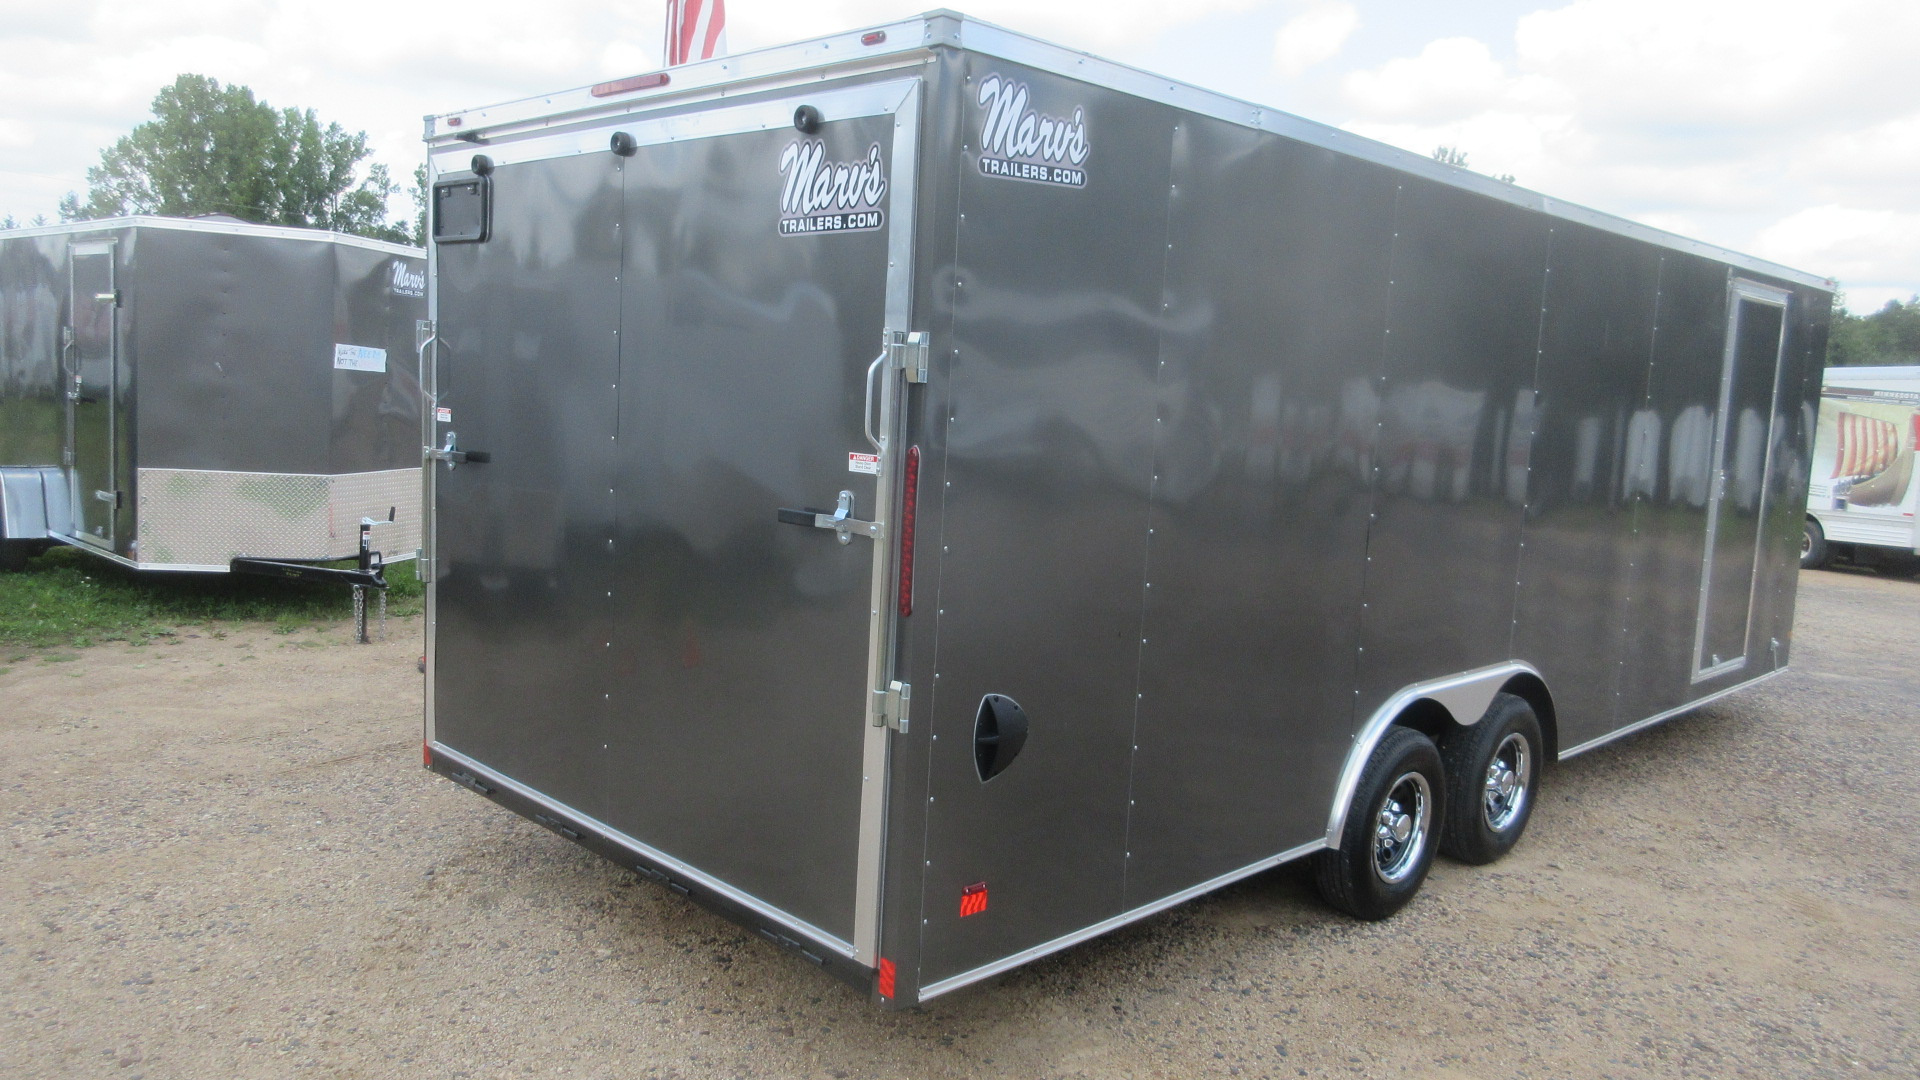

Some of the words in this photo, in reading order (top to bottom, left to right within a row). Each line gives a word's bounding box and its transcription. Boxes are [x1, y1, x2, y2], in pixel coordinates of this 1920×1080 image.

[980, 77, 1087, 165] Marv's
[781, 143, 884, 215] Marv's
[982, 158, 1082, 185] TRAILERS.COM
[782, 212, 878, 233] TRAILERS.COM
[393, 260, 425, 289] Marv's
